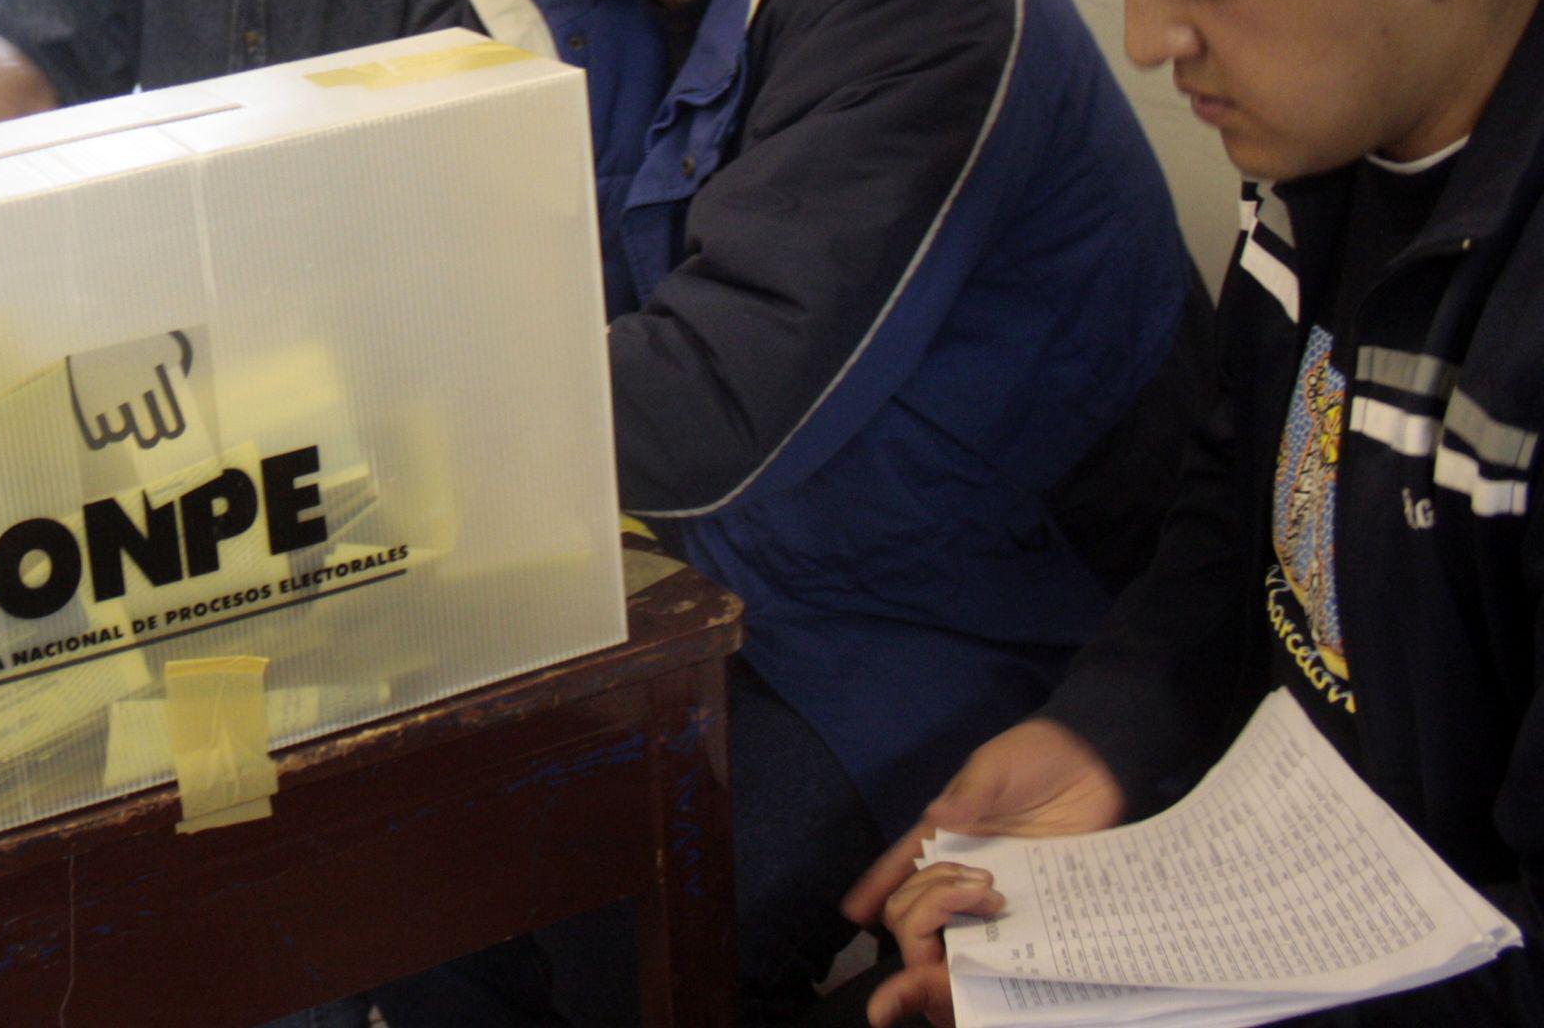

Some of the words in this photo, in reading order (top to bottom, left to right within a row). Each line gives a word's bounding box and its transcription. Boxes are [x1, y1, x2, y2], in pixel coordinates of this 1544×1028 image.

[12, 623, 124, 668] NACIONAL
[132, 614, 158, 637] DE
[165, 583, 273, 626] PROCESOS
[279, 544, 409, 594] ELECTORALES
